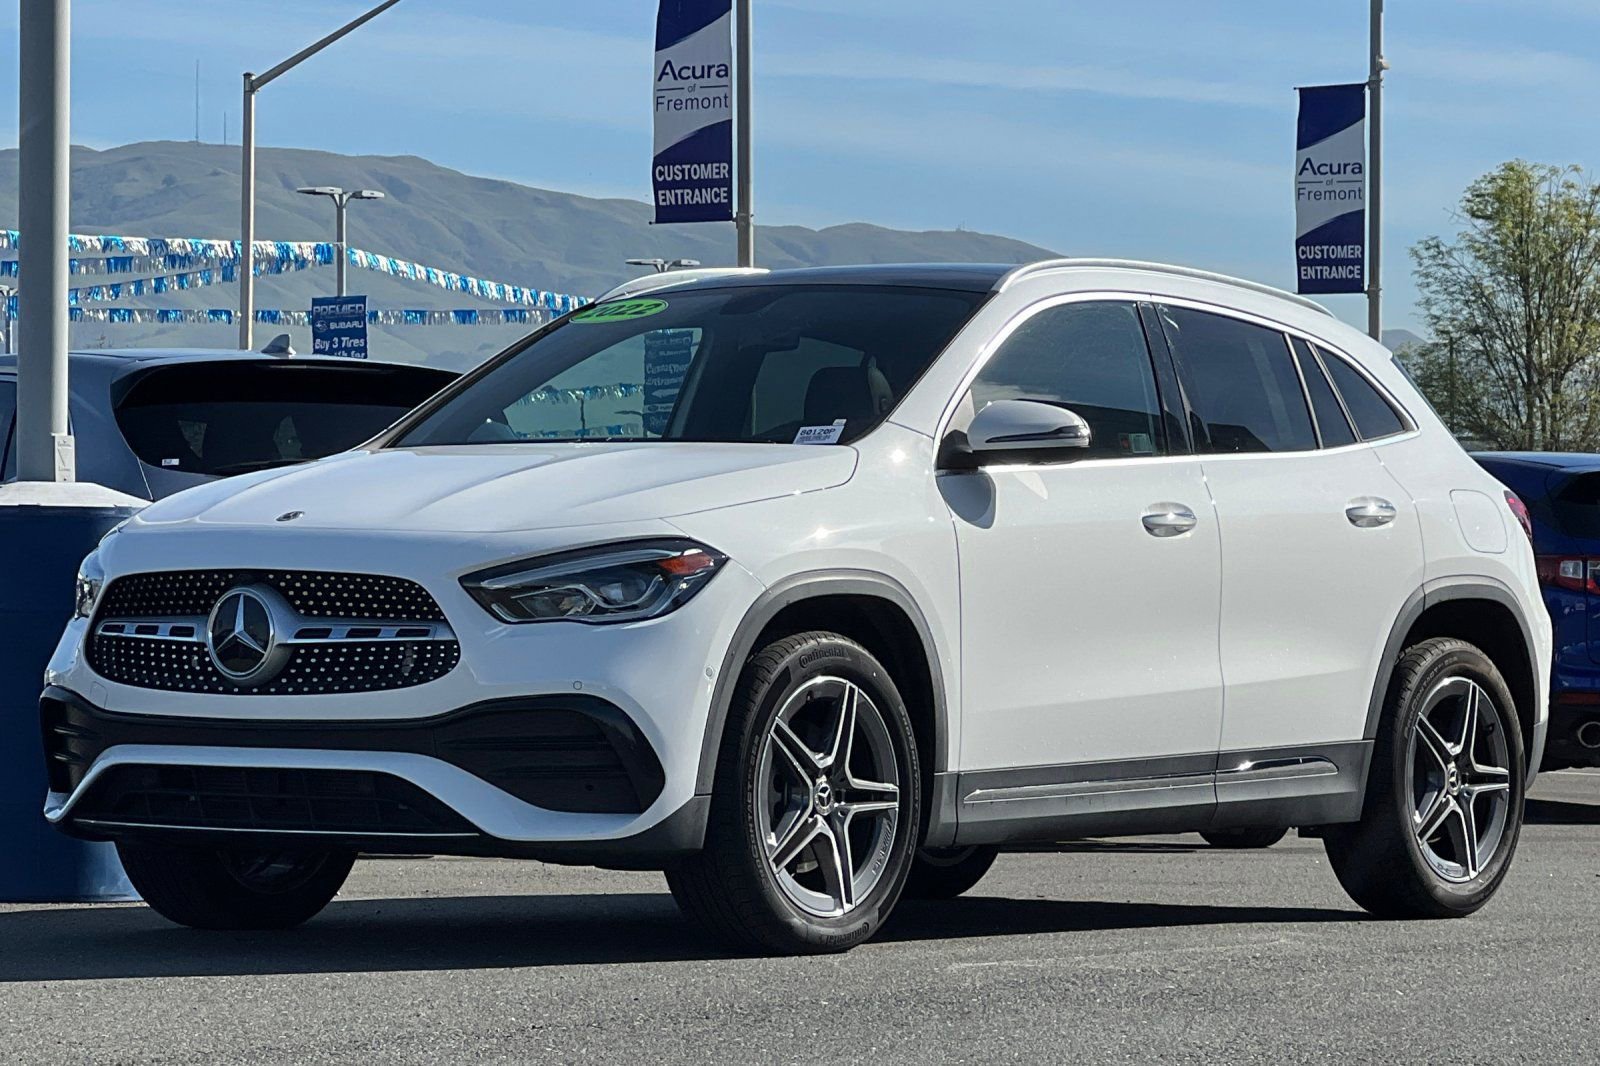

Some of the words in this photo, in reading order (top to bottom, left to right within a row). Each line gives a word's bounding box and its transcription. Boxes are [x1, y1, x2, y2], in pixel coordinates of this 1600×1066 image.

[657, 59, 729, 82] Acura
[687, 83, 697, 93] of
[656, 93, 729, 112] Fremont
[655, 162, 729, 182] CUSTOMER
[1298, 157, 1362, 176] Acura
[1325, 177, 1334, 186] of
[657, 187, 729, 206] ENTRANCE
[1297, 186, 1362, 201] Fremont
[1298, 245, 1362, 259] CUSTOMER
[1300, 265, 1361, 280] ENTRANCE
[573, 302, 663, 319] 2022
[329, 320, 364, 330] SUBARU
[314, 338, 330, 351] Buy
[332, 337, 339, 348] 3
[341, 336, 365, 348] Tires
